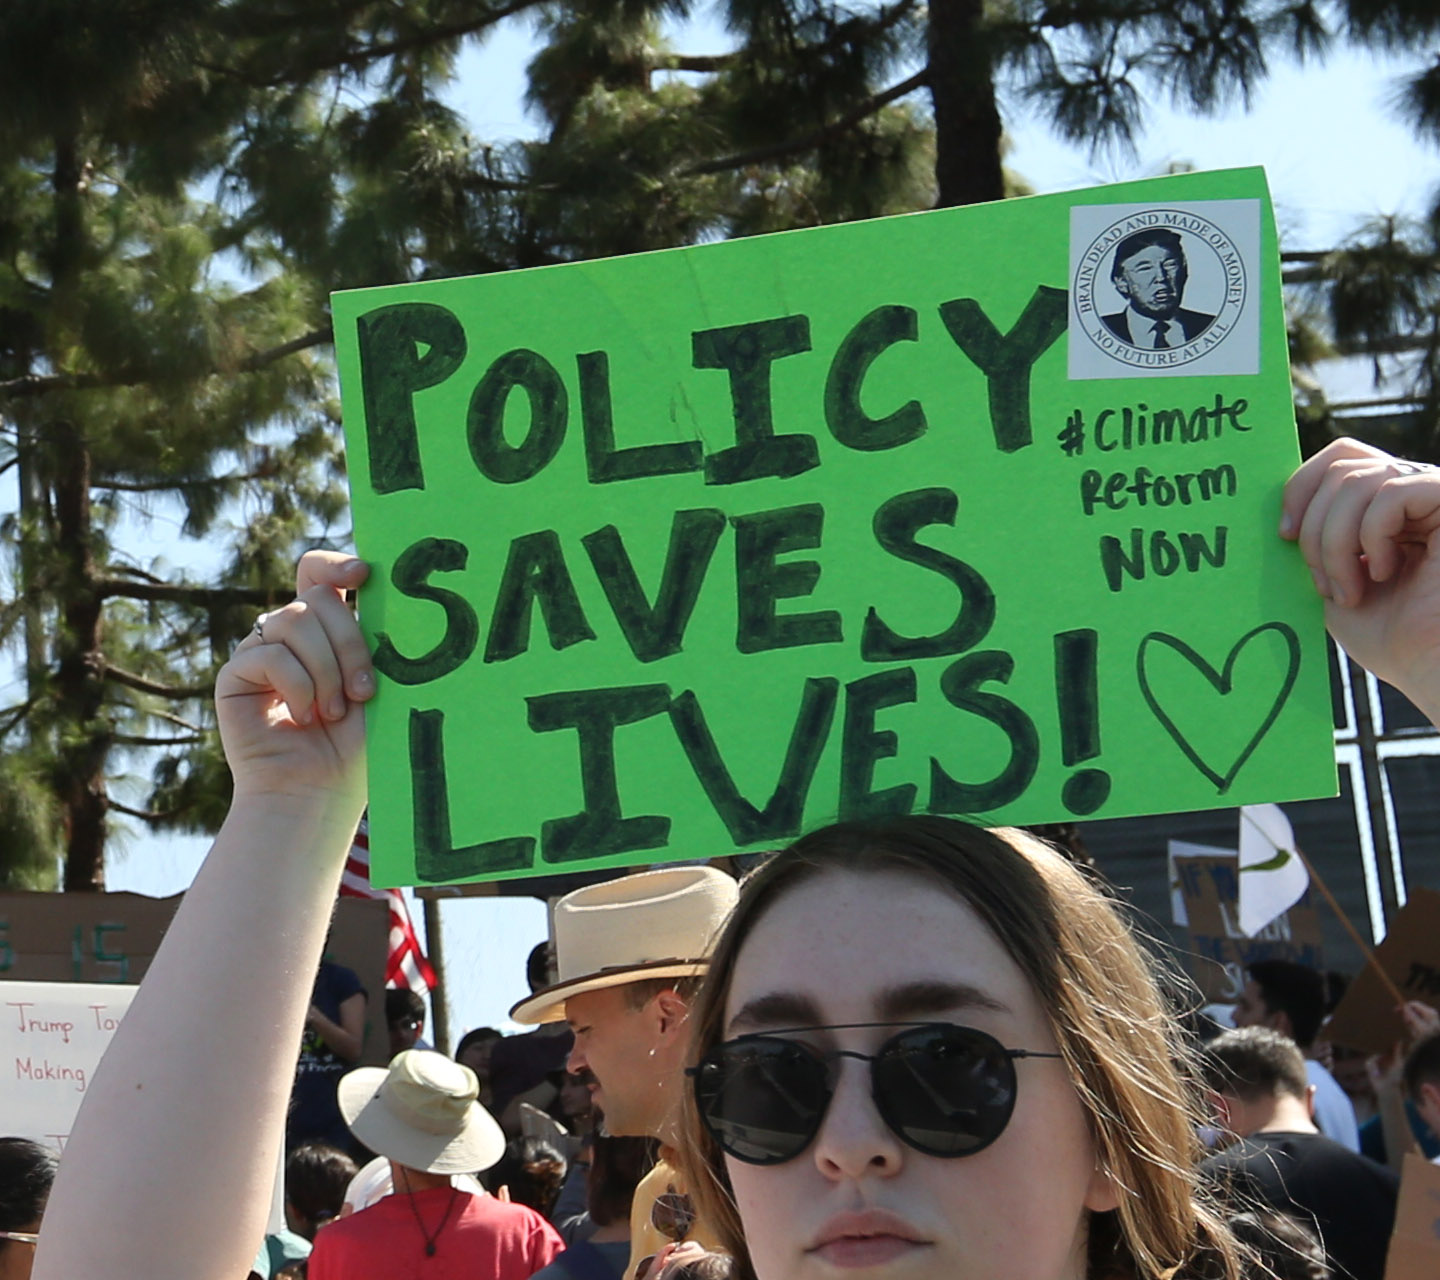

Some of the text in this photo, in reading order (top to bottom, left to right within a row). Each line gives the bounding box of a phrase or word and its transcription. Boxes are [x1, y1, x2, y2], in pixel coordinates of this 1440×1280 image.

[1078, 213, 1242, 314] BRAIN DEAD AND MADE OF MONEY
[1092, 322, 1230, 365] NO FUTURE AT ALL
[357, 284, 1069, 496] POLICY
[1057, 394, 1252, 457] #Climate
[373, 486, 996, 687] SAVES
[1099, 525, 1228, 593] NOW
[407, 627, 1112, 882] LIVES!
[73, 922, 128, 984] IS
[6, 1002, 74, 1044] Trump
[16, 1057, 85, 1092] Making
